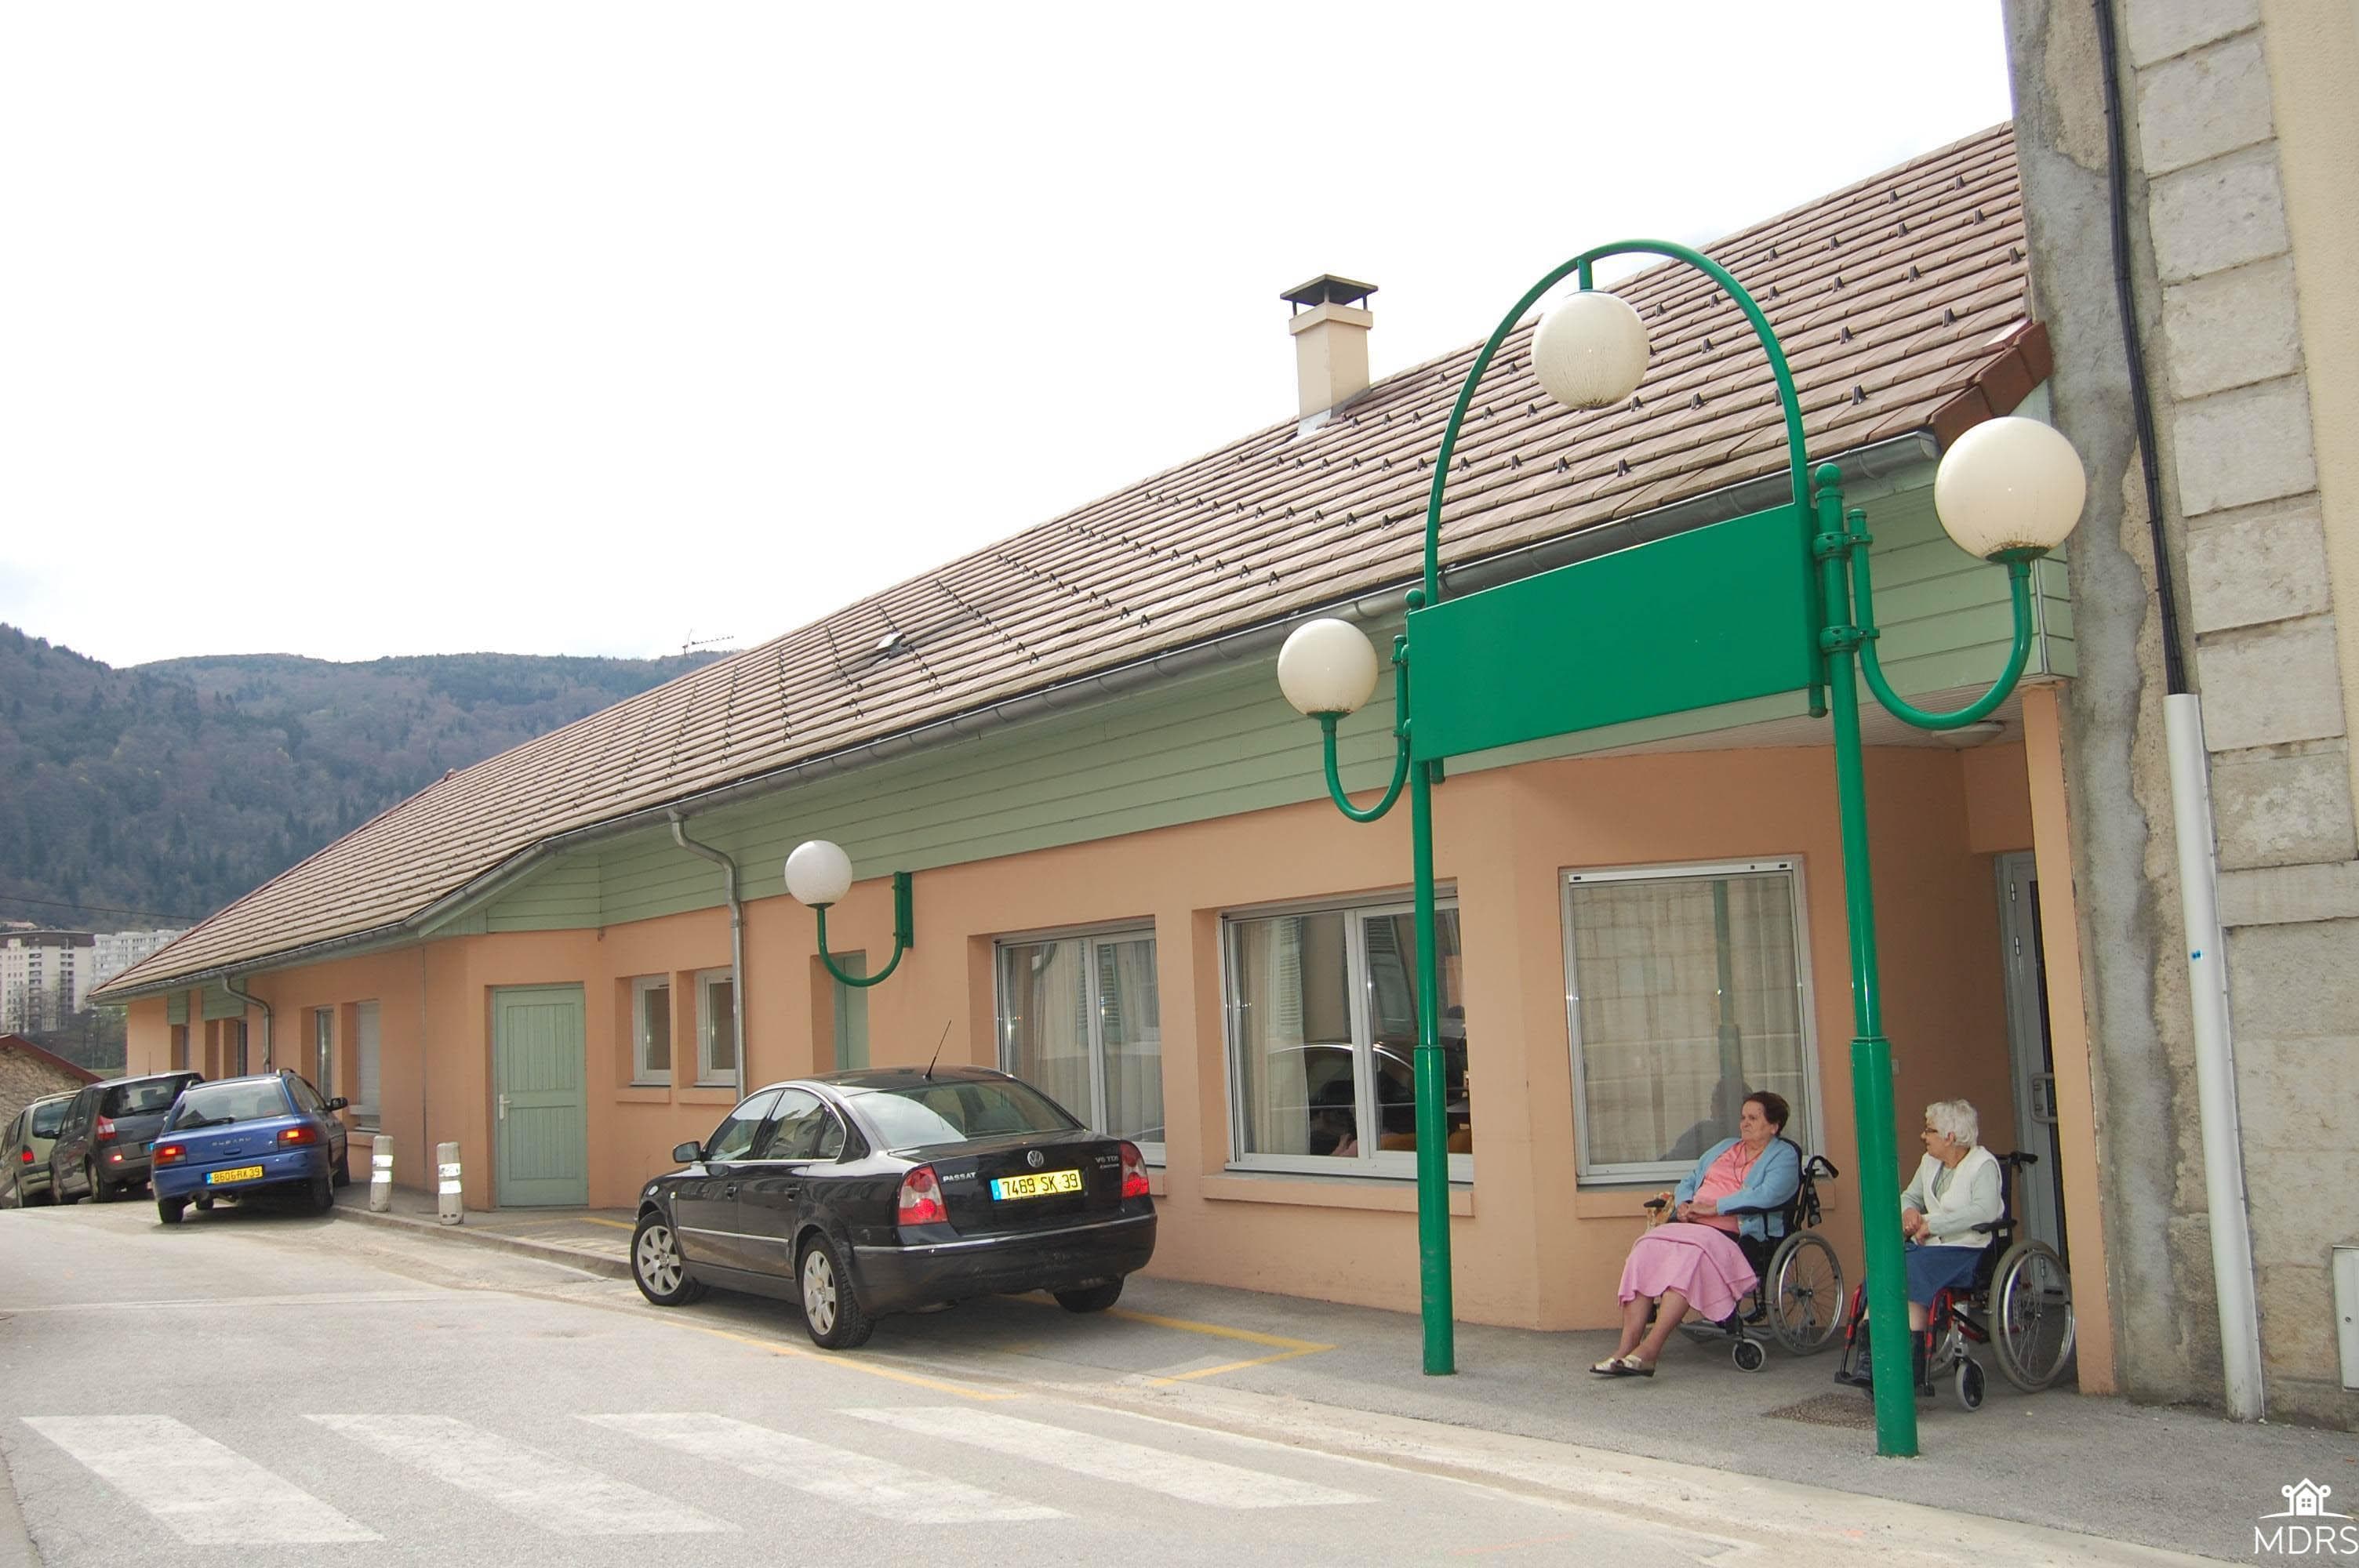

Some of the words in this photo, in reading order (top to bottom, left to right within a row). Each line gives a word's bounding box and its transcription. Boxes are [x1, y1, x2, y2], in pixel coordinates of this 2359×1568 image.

[943, 1171, 976, 1182] PASSAT
[1041, 1176, 1059, 1192] SK
[1062, 1174, 1079, 1189] 39
